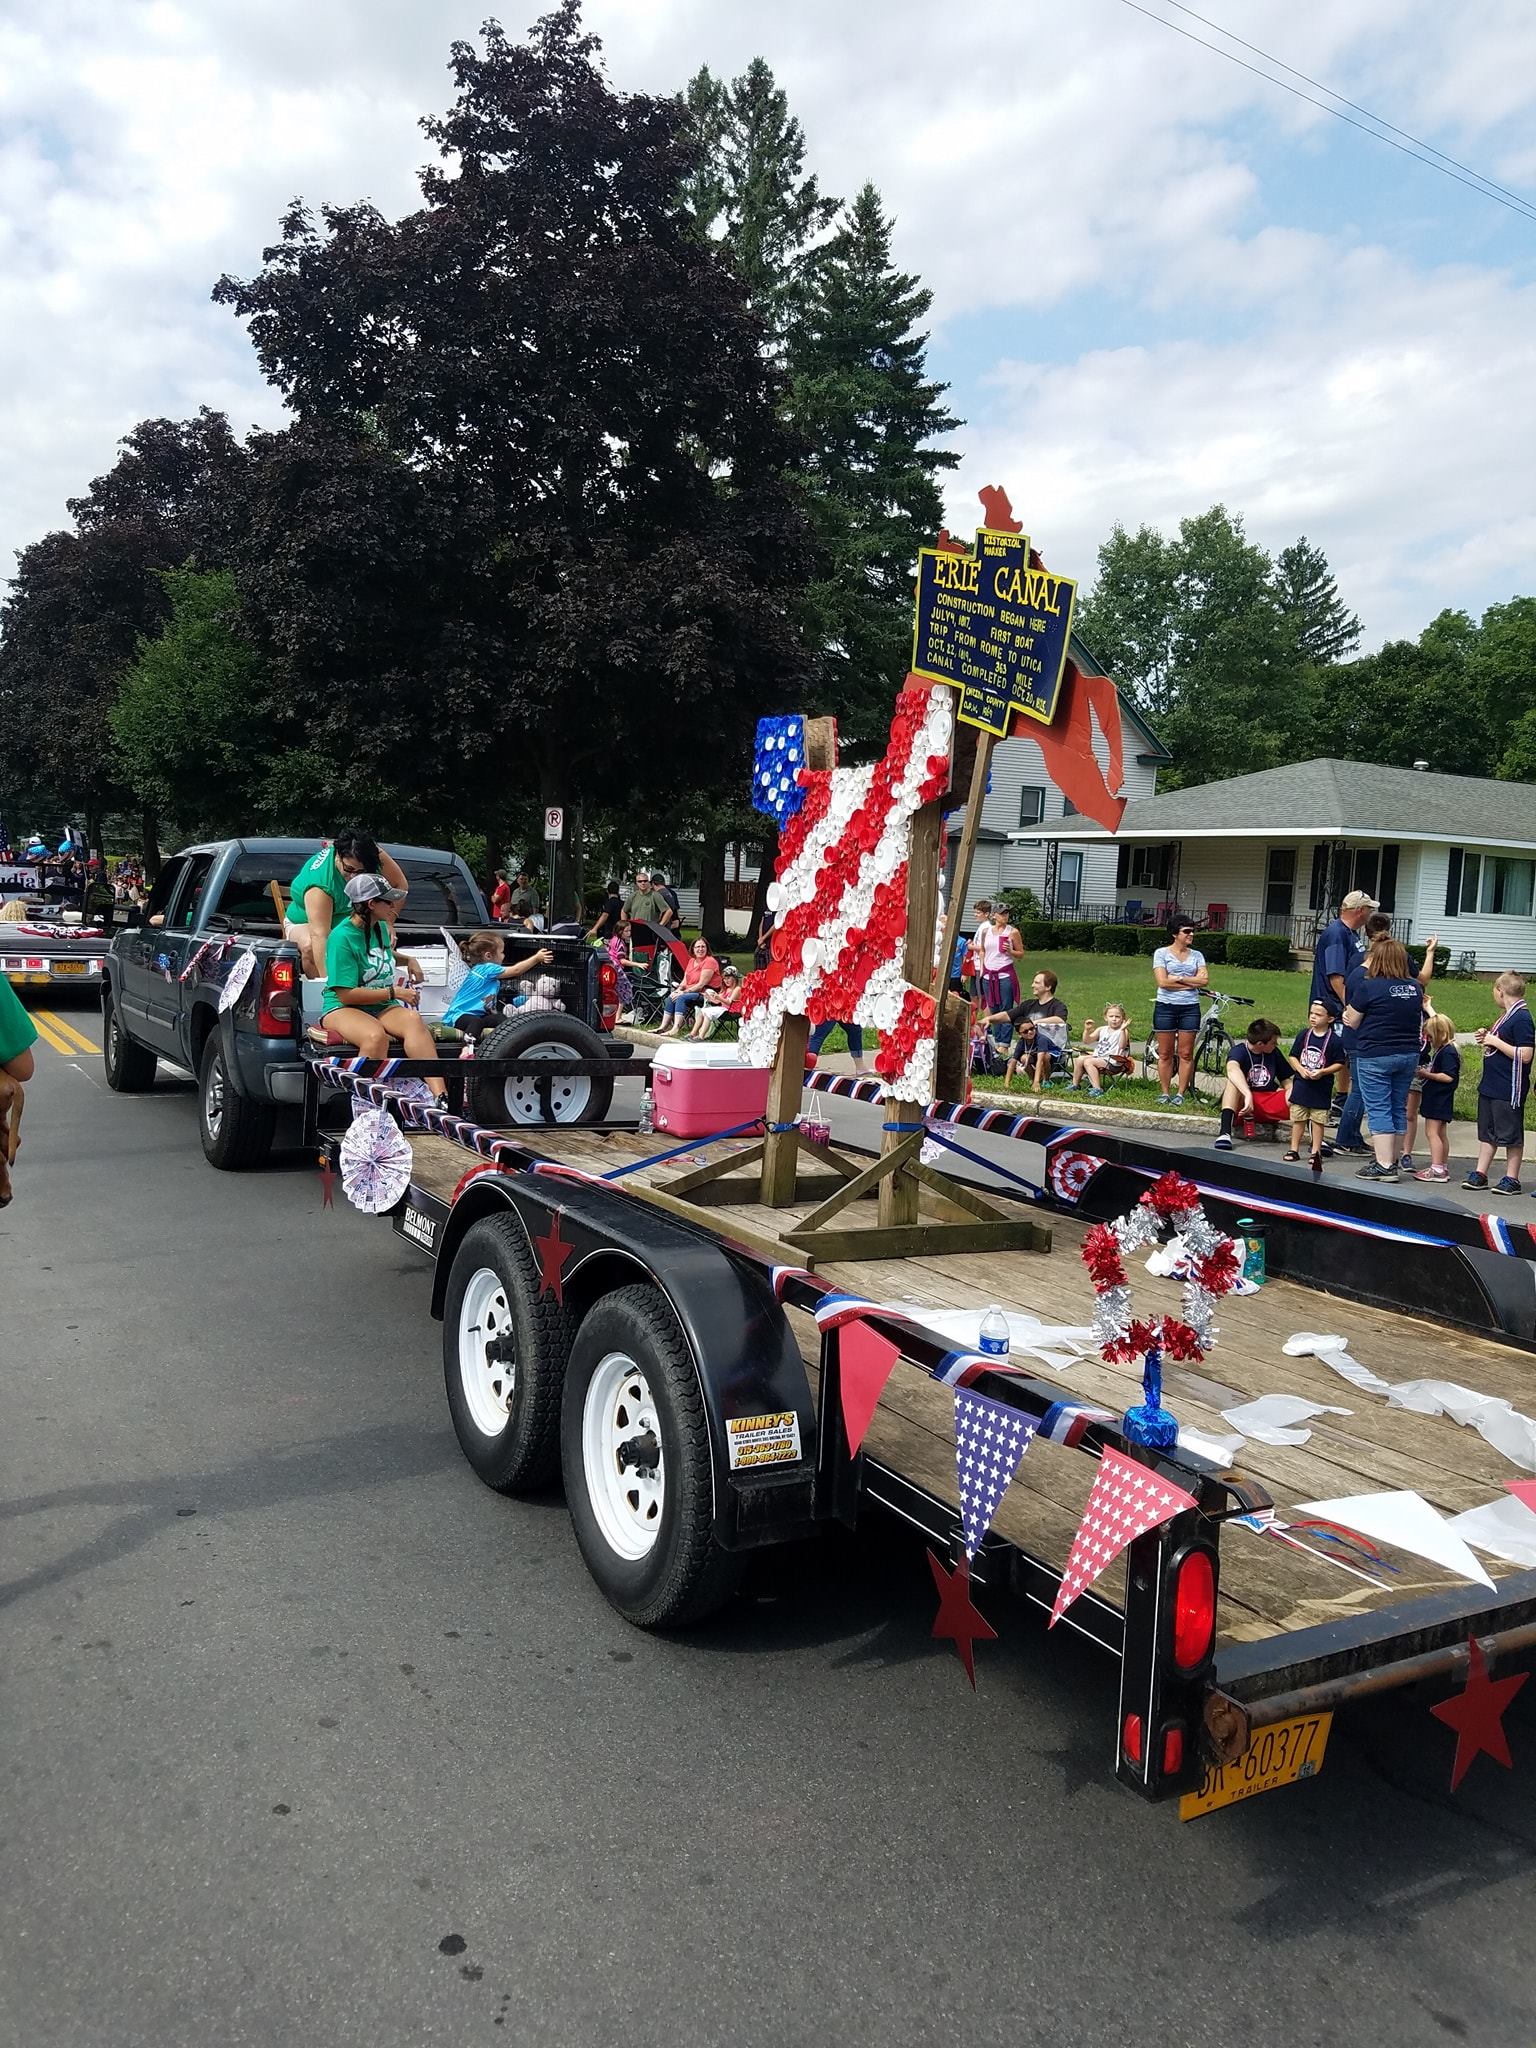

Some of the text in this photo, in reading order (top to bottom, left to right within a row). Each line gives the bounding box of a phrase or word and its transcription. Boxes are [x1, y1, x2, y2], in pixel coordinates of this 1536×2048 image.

[984, 535, 1021, 549] HISTORICAL
[984, 546, 1007, 557] MARKER
[933, 553, 1060, 617] ERIE CANAL
[937, 592, 1047, 633] CONSTRUCTION BEGAN HERE
[929, 622, 1042, 673] TRIP FROM ROME TO UTICA
[990, 627, 1011, 644] FIRST
[1014, 635, 1034, 651] BOAT
[926, 651, 954, 670] CANAL
[961, 662, 1007, 689] COMPLETED
[994, 661, 1007, 675] 363
[1015, 672, 1033, 690] MILE
[965, 687, 1007, 711] ONEIDA COUNTY
[405, 1207, 436, 1237] BELMONT
[730, 1413, 794, 1434] KINNEY'S
[735, 1431, 766, 1439] TRAILER
[767, 1427, 793, 1435] SALES
[1245, 1720, 1320, 1781] 60377
[1231, 1776, 1279, 1799] TRAILER
